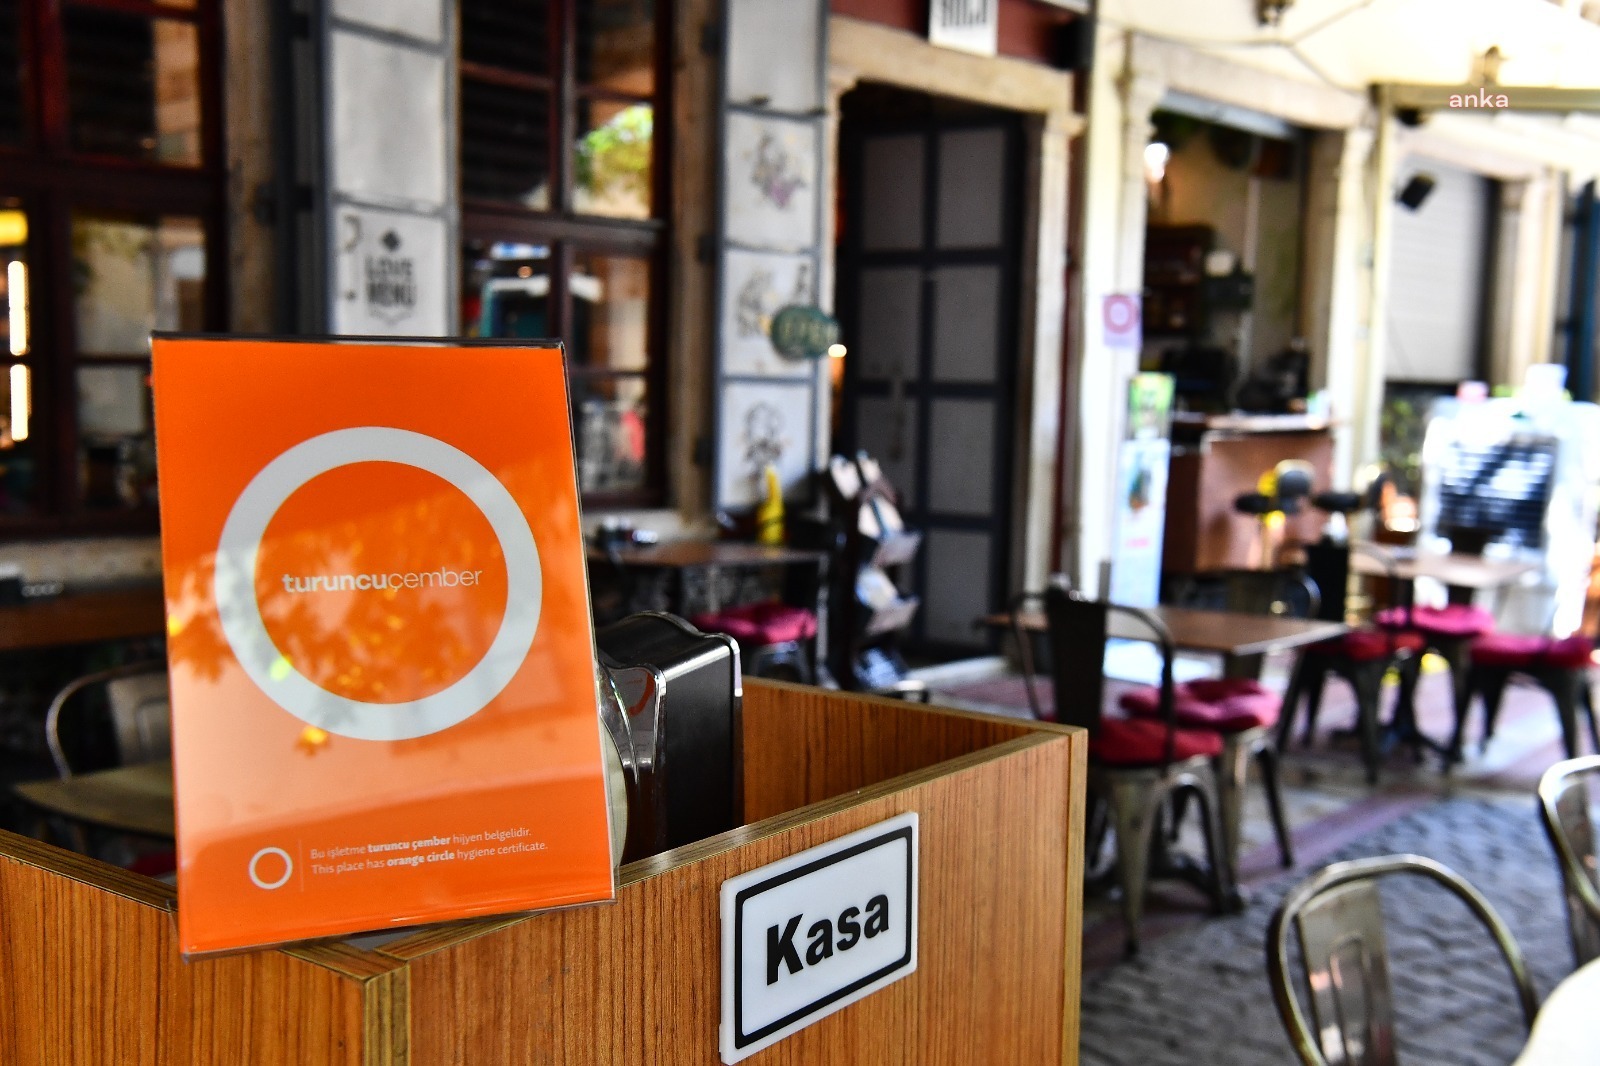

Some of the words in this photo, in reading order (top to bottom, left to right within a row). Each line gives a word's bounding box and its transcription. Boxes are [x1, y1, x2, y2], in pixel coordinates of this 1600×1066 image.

[310, 848, 325, 859] Bu
[367, 843, 410, 853] turuncu
[412, 835, 451, 851] çember
[452, 833, 482, 845] hijyen
[484, 827, 532, 842] belgelidir.
[311, 864, 335, 874] This
[336, 861, 364, 874] place
[366, 859, 385, 869] has
[386, 855, 425, 867] orange
[426, 850, 456, 863] circle
[456, 848, 495, 860] hygiene
[497, 842, 549, 855] certificate.
[766, 894, 890, 987] Kasa
